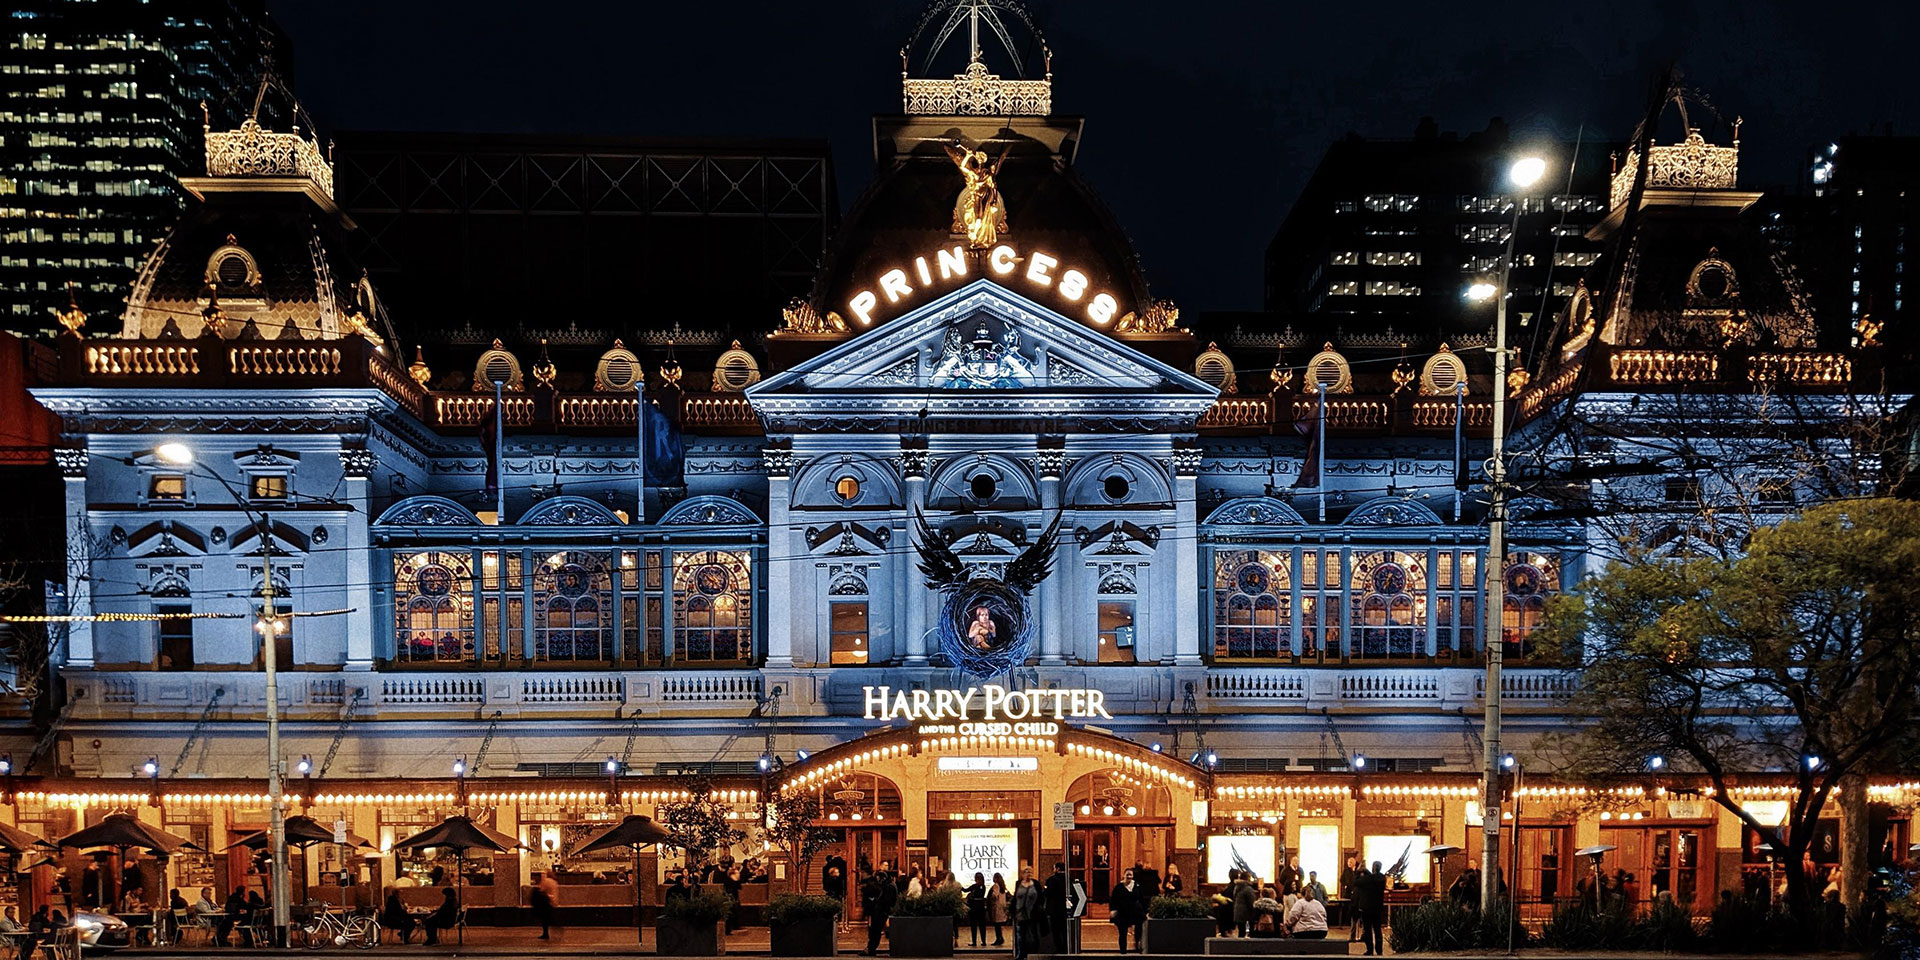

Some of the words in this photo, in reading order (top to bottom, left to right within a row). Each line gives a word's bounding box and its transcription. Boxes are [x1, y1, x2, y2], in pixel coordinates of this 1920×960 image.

[848, 244, 1119, 325] PRINCESS
[862, 685, 977, 721] HARRY
[983, 684, 1114, 720] POTTER
[958, 722, 1012, 736] CURSED
[1014, 722, 1059, 736] CHILD
[962, 844, 1007, 858] HARRY
[960, 857, 1009, 871] POTTER
